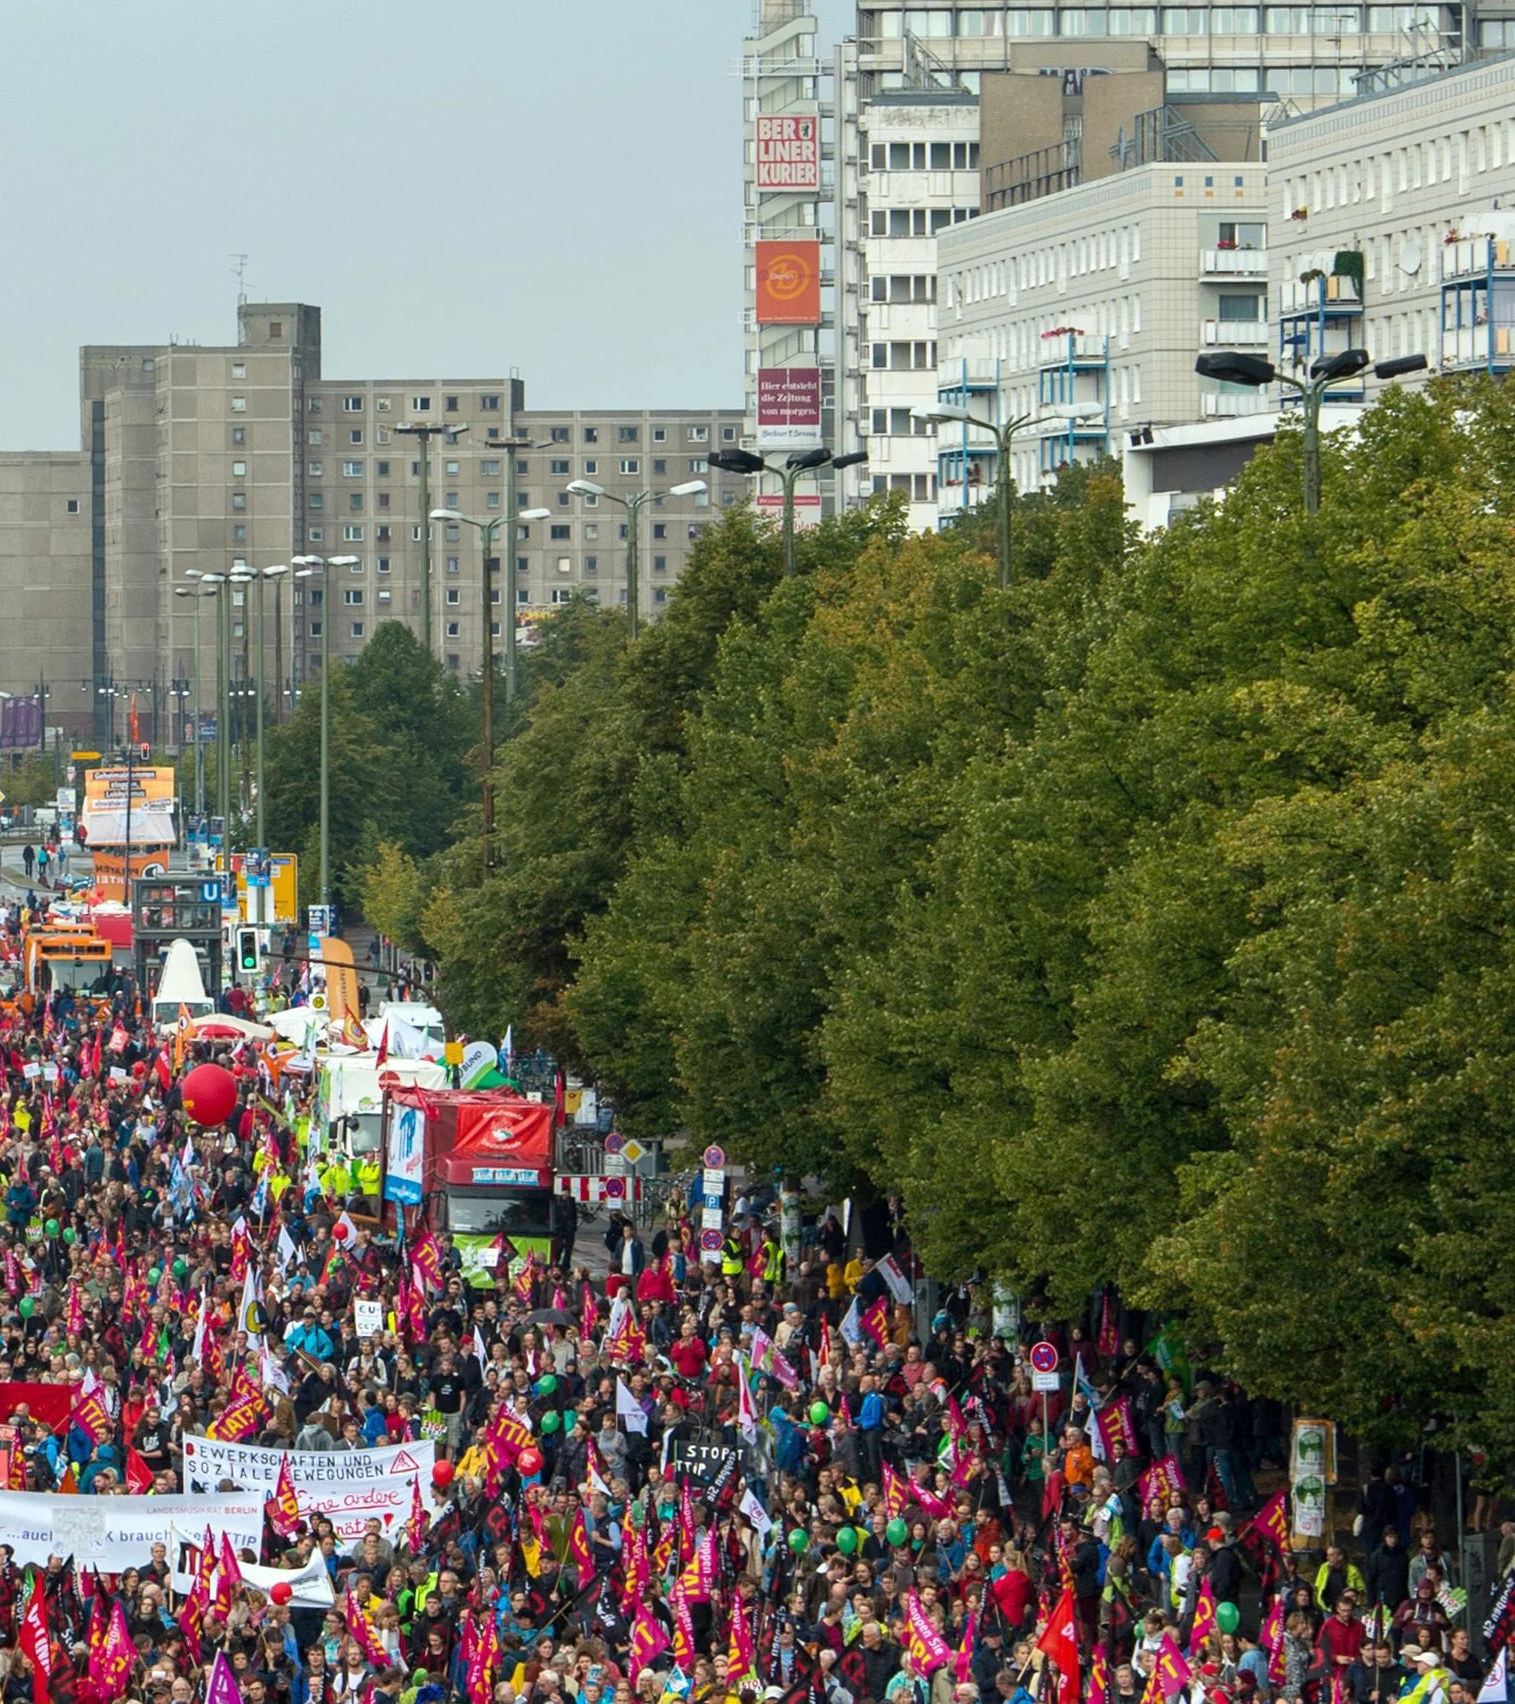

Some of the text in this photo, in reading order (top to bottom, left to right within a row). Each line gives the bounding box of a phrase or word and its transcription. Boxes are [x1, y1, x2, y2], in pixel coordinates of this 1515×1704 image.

[759, 119, 796, 140] BER
[759, 141, 815, 161] LINER
[759, 163, 815, 184] KURIER
[761, 382, 817, 390] Hier entsteht
[761, 393, 812, 403] die Zeitung
[780, 408, 817, 417] morgen.
[204, 885, 218, 900] U
[461, 1050, 483, 1072] BUND
[708, 1196, 716, 1208] P
[497, 1417, 537, 1448] TTIP
[344, 1454, 372, 1467] UND
[687, 1443, 744, 1460] STOPT
[188, 1460, 384, 1482] SOZIALE EWEGUNGEN
[343, 1487, 404, 1507] andere
[146, 1505, 258, 1515] LANDESMUSIKRAT BERLIN
[120, 1528, 172, 1542] brauch
[336, 1517, 367, 1536] nöti
[908, 1594, 944, 1656] Stoppen Sie
